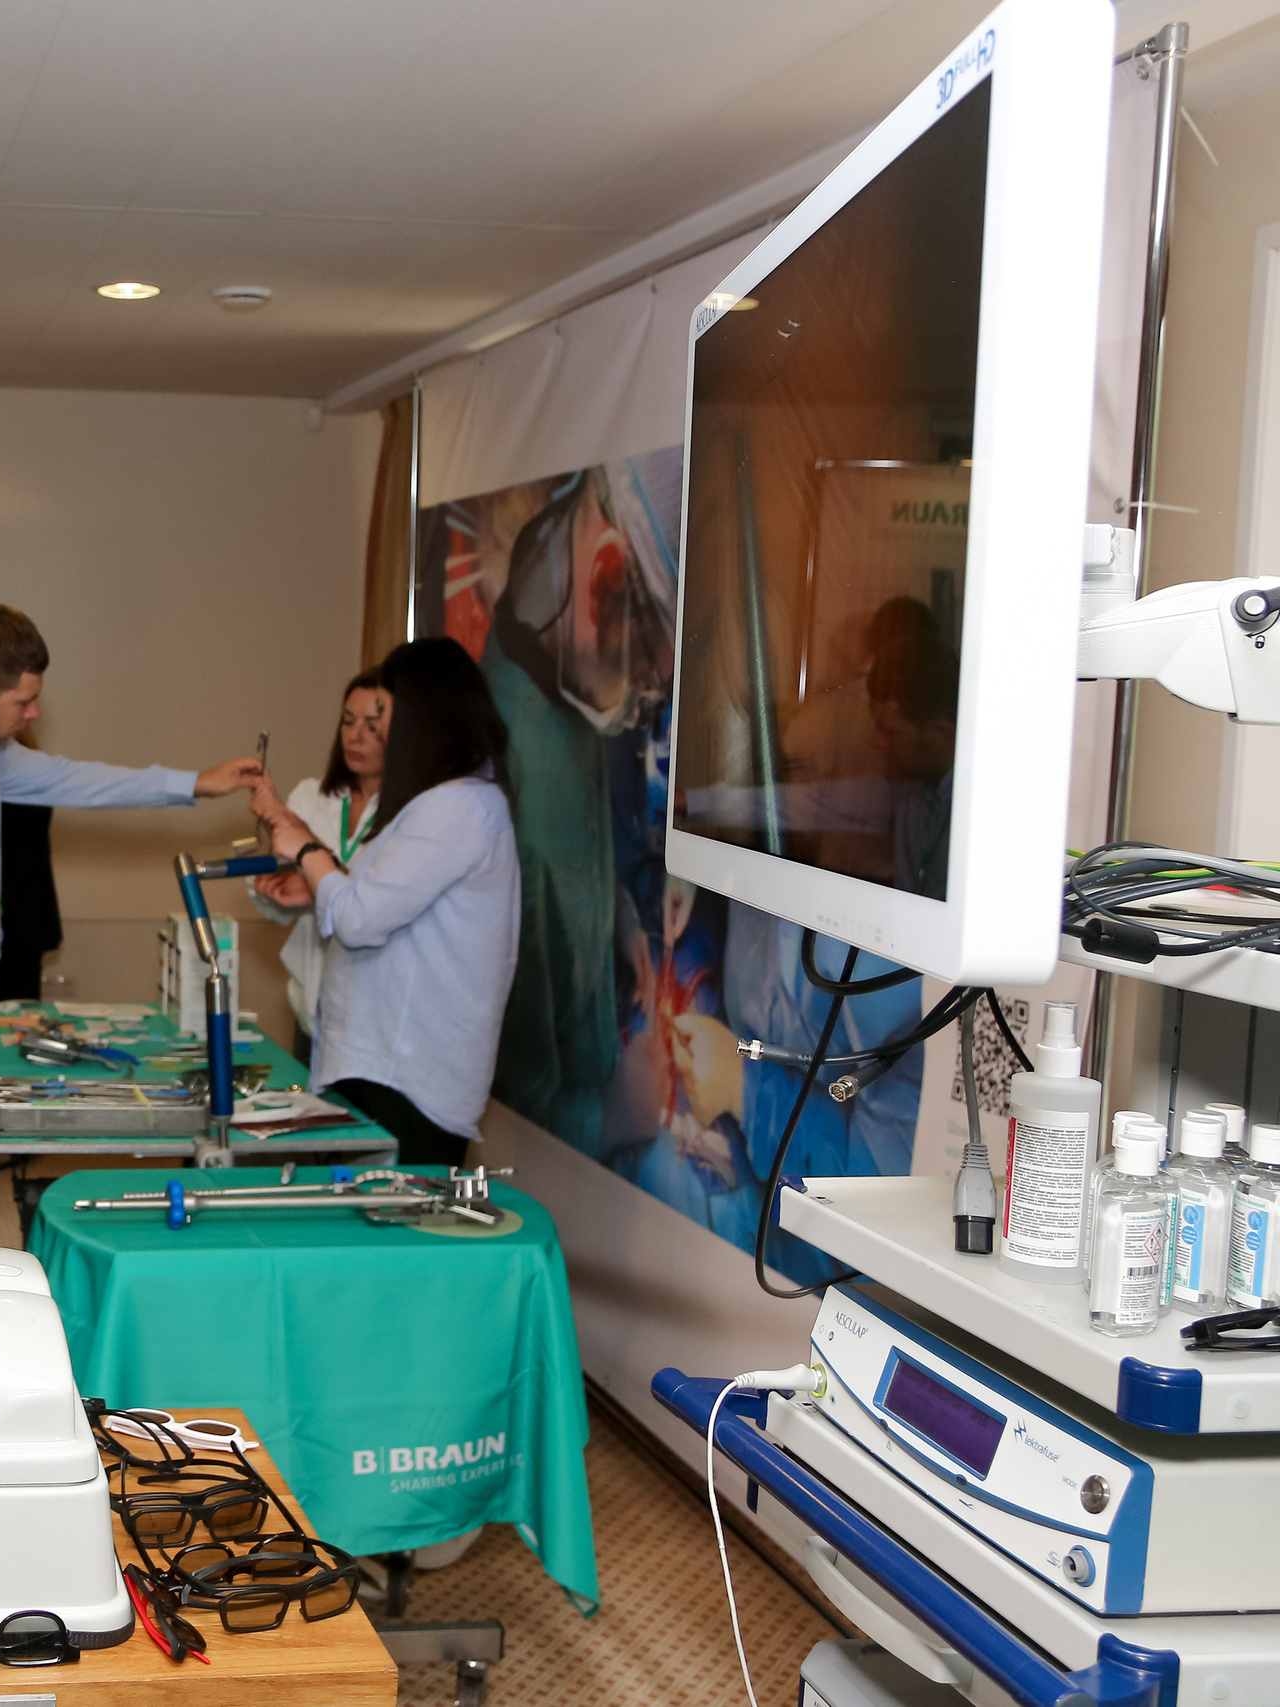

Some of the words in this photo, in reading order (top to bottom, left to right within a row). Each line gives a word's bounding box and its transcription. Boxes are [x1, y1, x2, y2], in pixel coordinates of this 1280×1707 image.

[936, 68, 954, 109] 3D
[977, 28, 996, 72] HD
[353, 1450, 377, 1475] B
[389, 1432, 506, 1473] BRAUN
[390, 1472, 456, 1494] SHARING
[1062, 1476, 1077, 1489] MODE
